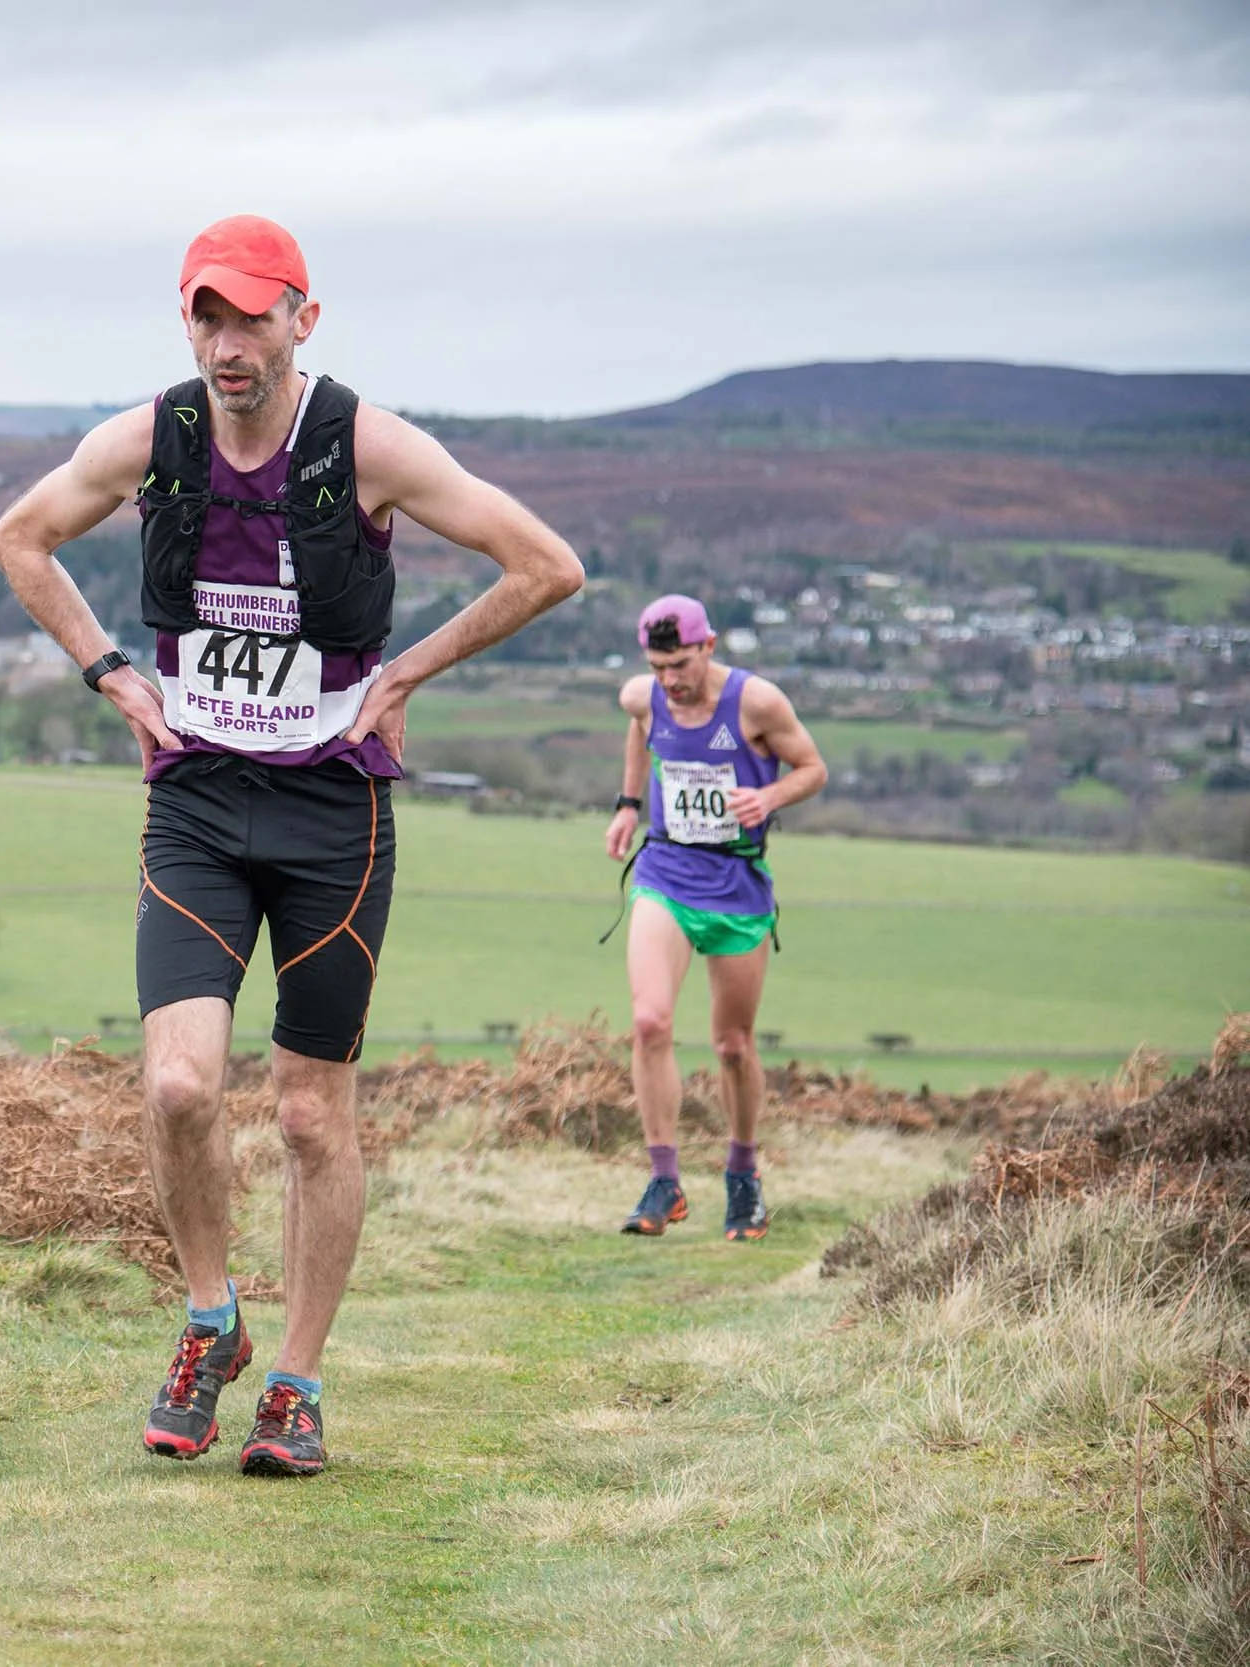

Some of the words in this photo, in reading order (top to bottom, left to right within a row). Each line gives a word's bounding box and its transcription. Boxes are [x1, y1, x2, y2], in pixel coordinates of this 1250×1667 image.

[192, 588, 301, 614] ORTHUMBERLA
[231, 612, 300, 632] RUNNERS
[197, 631, 302, 697] 447
[187, 692, 234, 717] PETE
[241, 702, 316, 721] BLAND
[213, 716, 278, 734] SPORTS
[675, 788, 725, 818] 440
